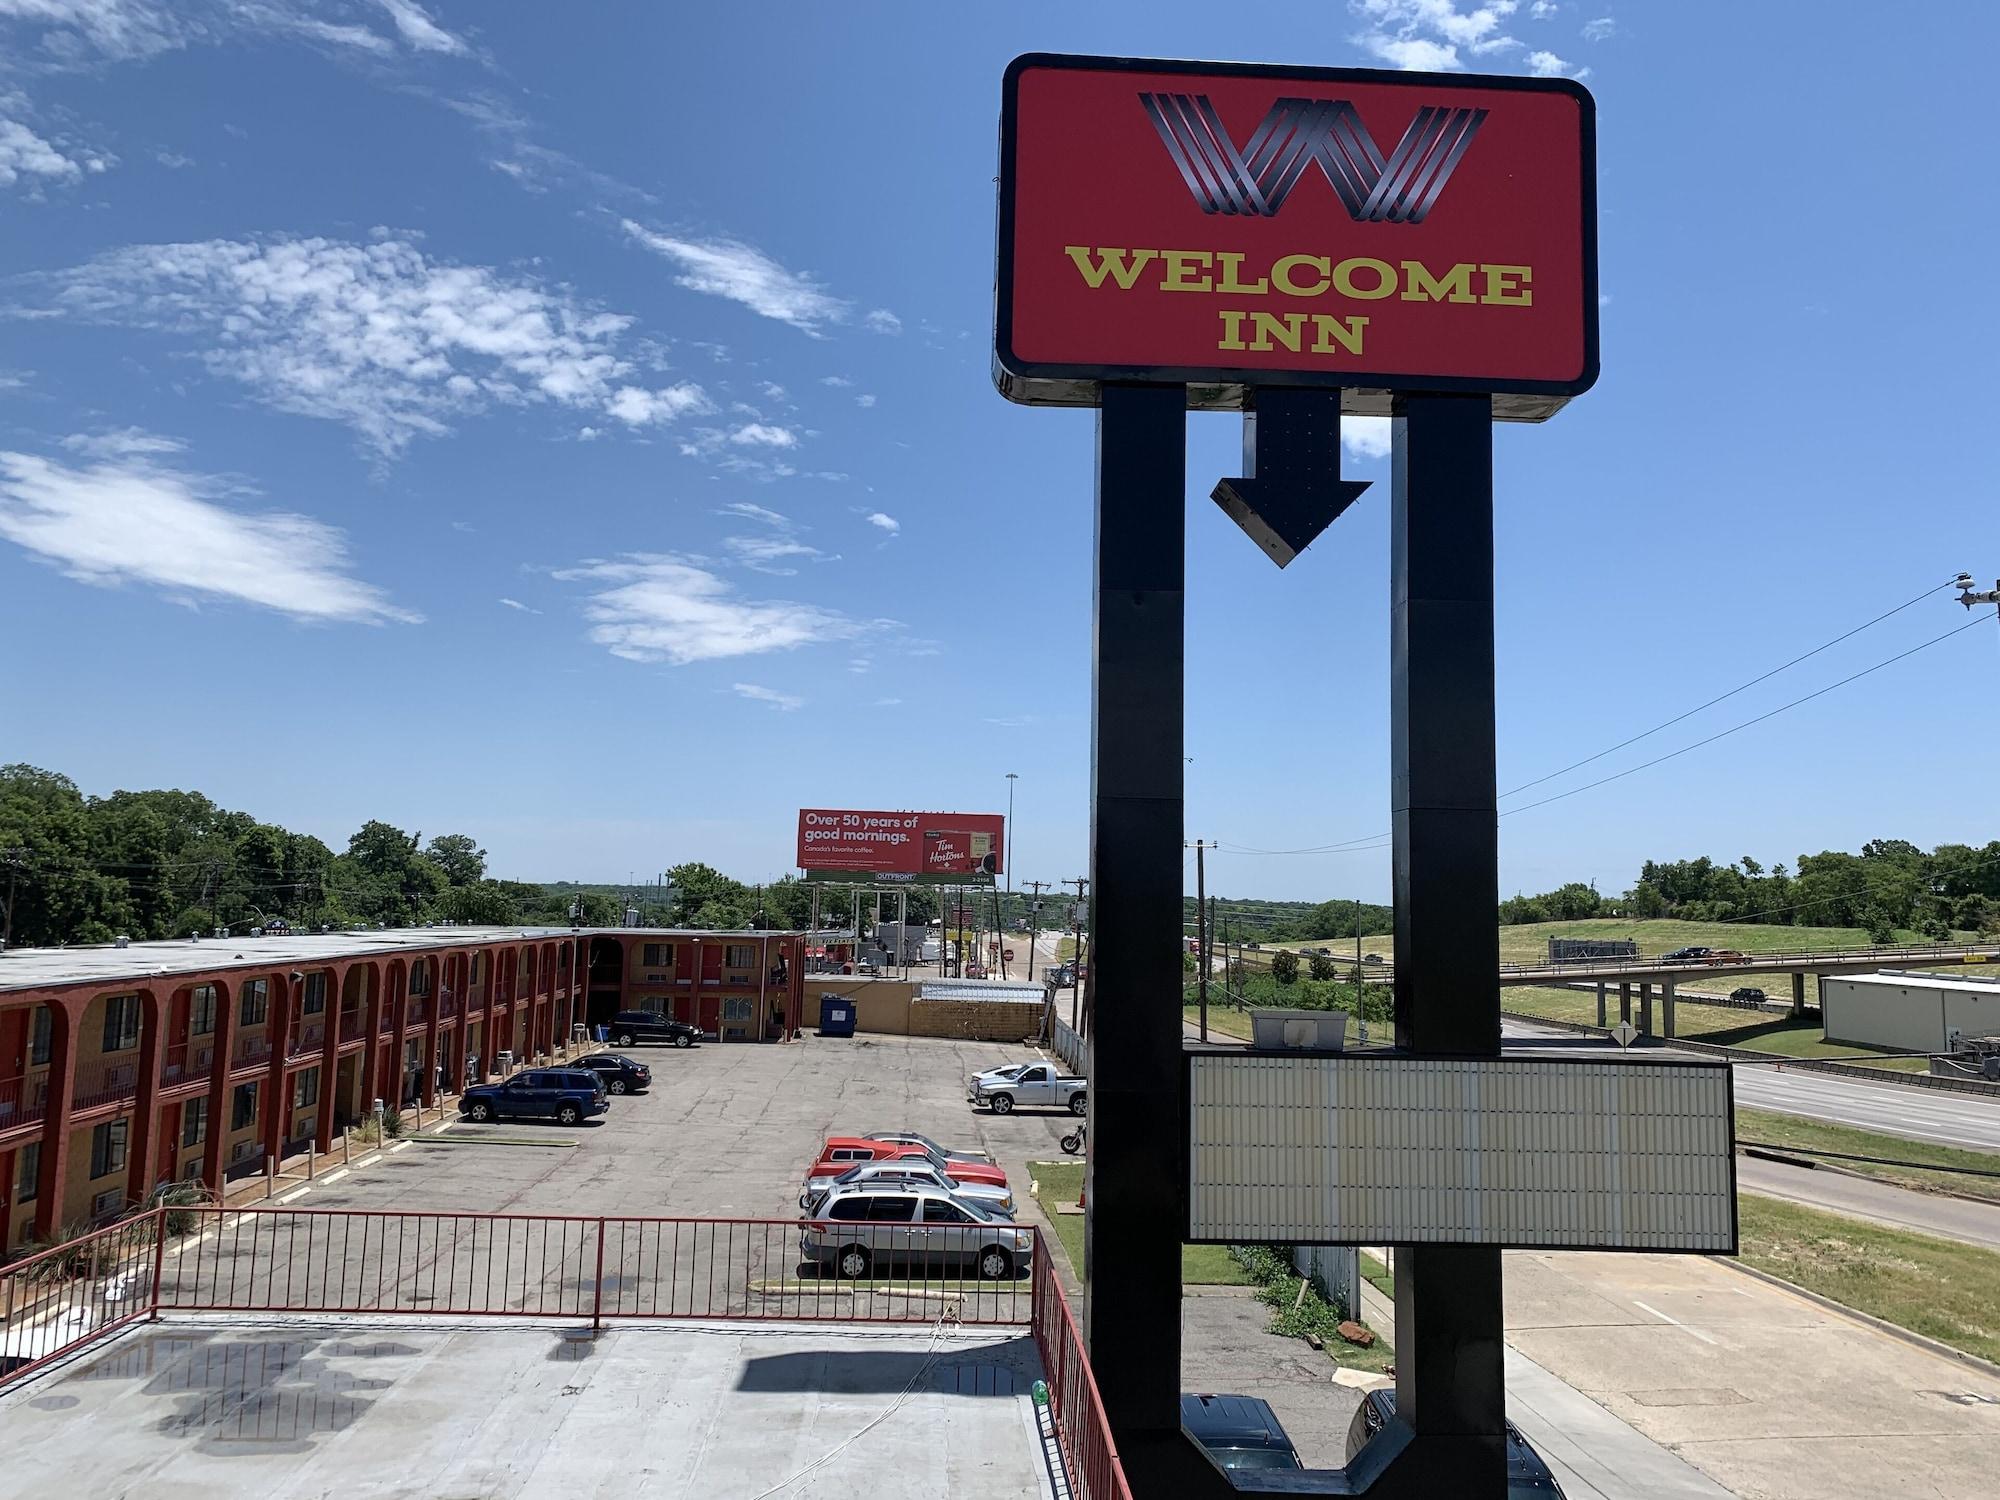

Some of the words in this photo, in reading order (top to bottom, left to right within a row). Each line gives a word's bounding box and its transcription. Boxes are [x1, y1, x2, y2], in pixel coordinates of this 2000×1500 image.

[1064, 245, 1533, 307] WELCOME
[1218, 310, 1370, 355] INN
[805, 812, 840, 826] Over
[843, 814, 860, 826] 50
[863, 817, 900, 830] years
[903, 816, 918, 828] of
[805, 827, 840, 843] good
[843, 829, 910, 846] mornings.
[935, 839, 953, 852] Tim
[929, 850, 965, 864] Hortons
[877, 872, 914, 881] OUTFRONT
